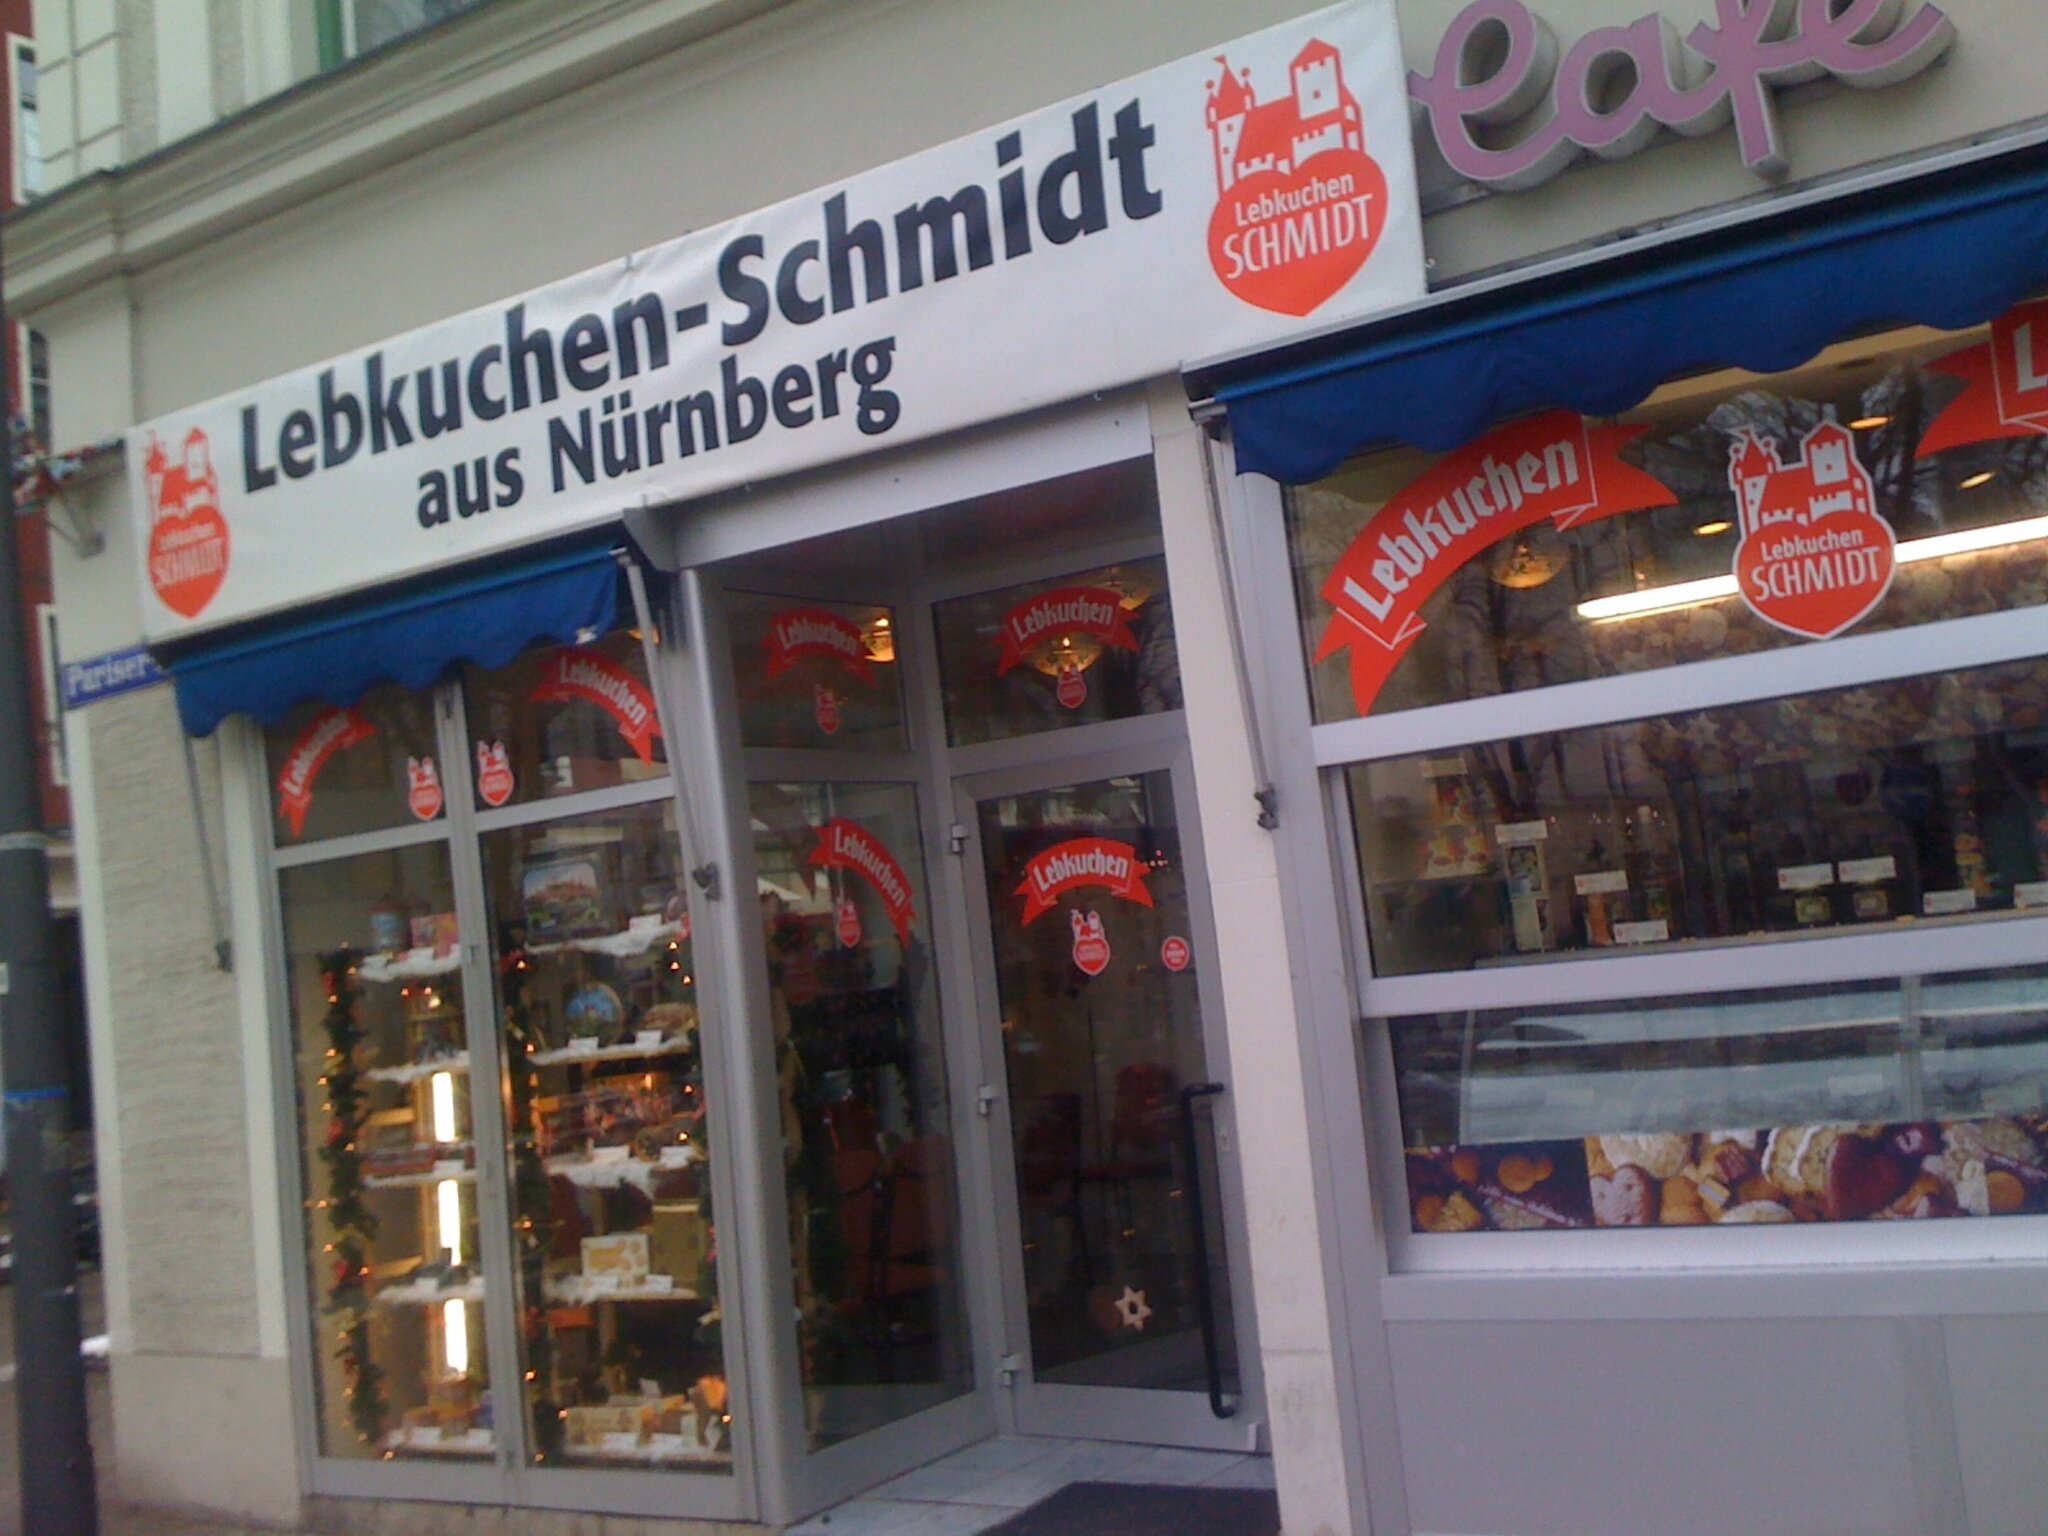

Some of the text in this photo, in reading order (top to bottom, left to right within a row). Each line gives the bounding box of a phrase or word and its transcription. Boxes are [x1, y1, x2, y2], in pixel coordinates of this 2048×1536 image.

[1235, 173, 1355, 227] Lebkuchen
[1223, 193, 1373, 279] SCHMIDT
[241, 97, 1163, 493] Lebkuchen-Schmidt
[417, 336, 901, 528] aus Nürnberg
[1343, 440, 1580, 623] Lebkuchen
[1760, 528, 1864, 562] Lebkuchen
[1751, 545, 1881, 602] SCHMIDT
[1011, 595, 1114, 641] Lebkuchen
[560, 654, 648, 725] Lebkuchen
[834, 824, 906, 908] Lebkuchen
[1033, 847, 1129, 892] Lebkuchen
